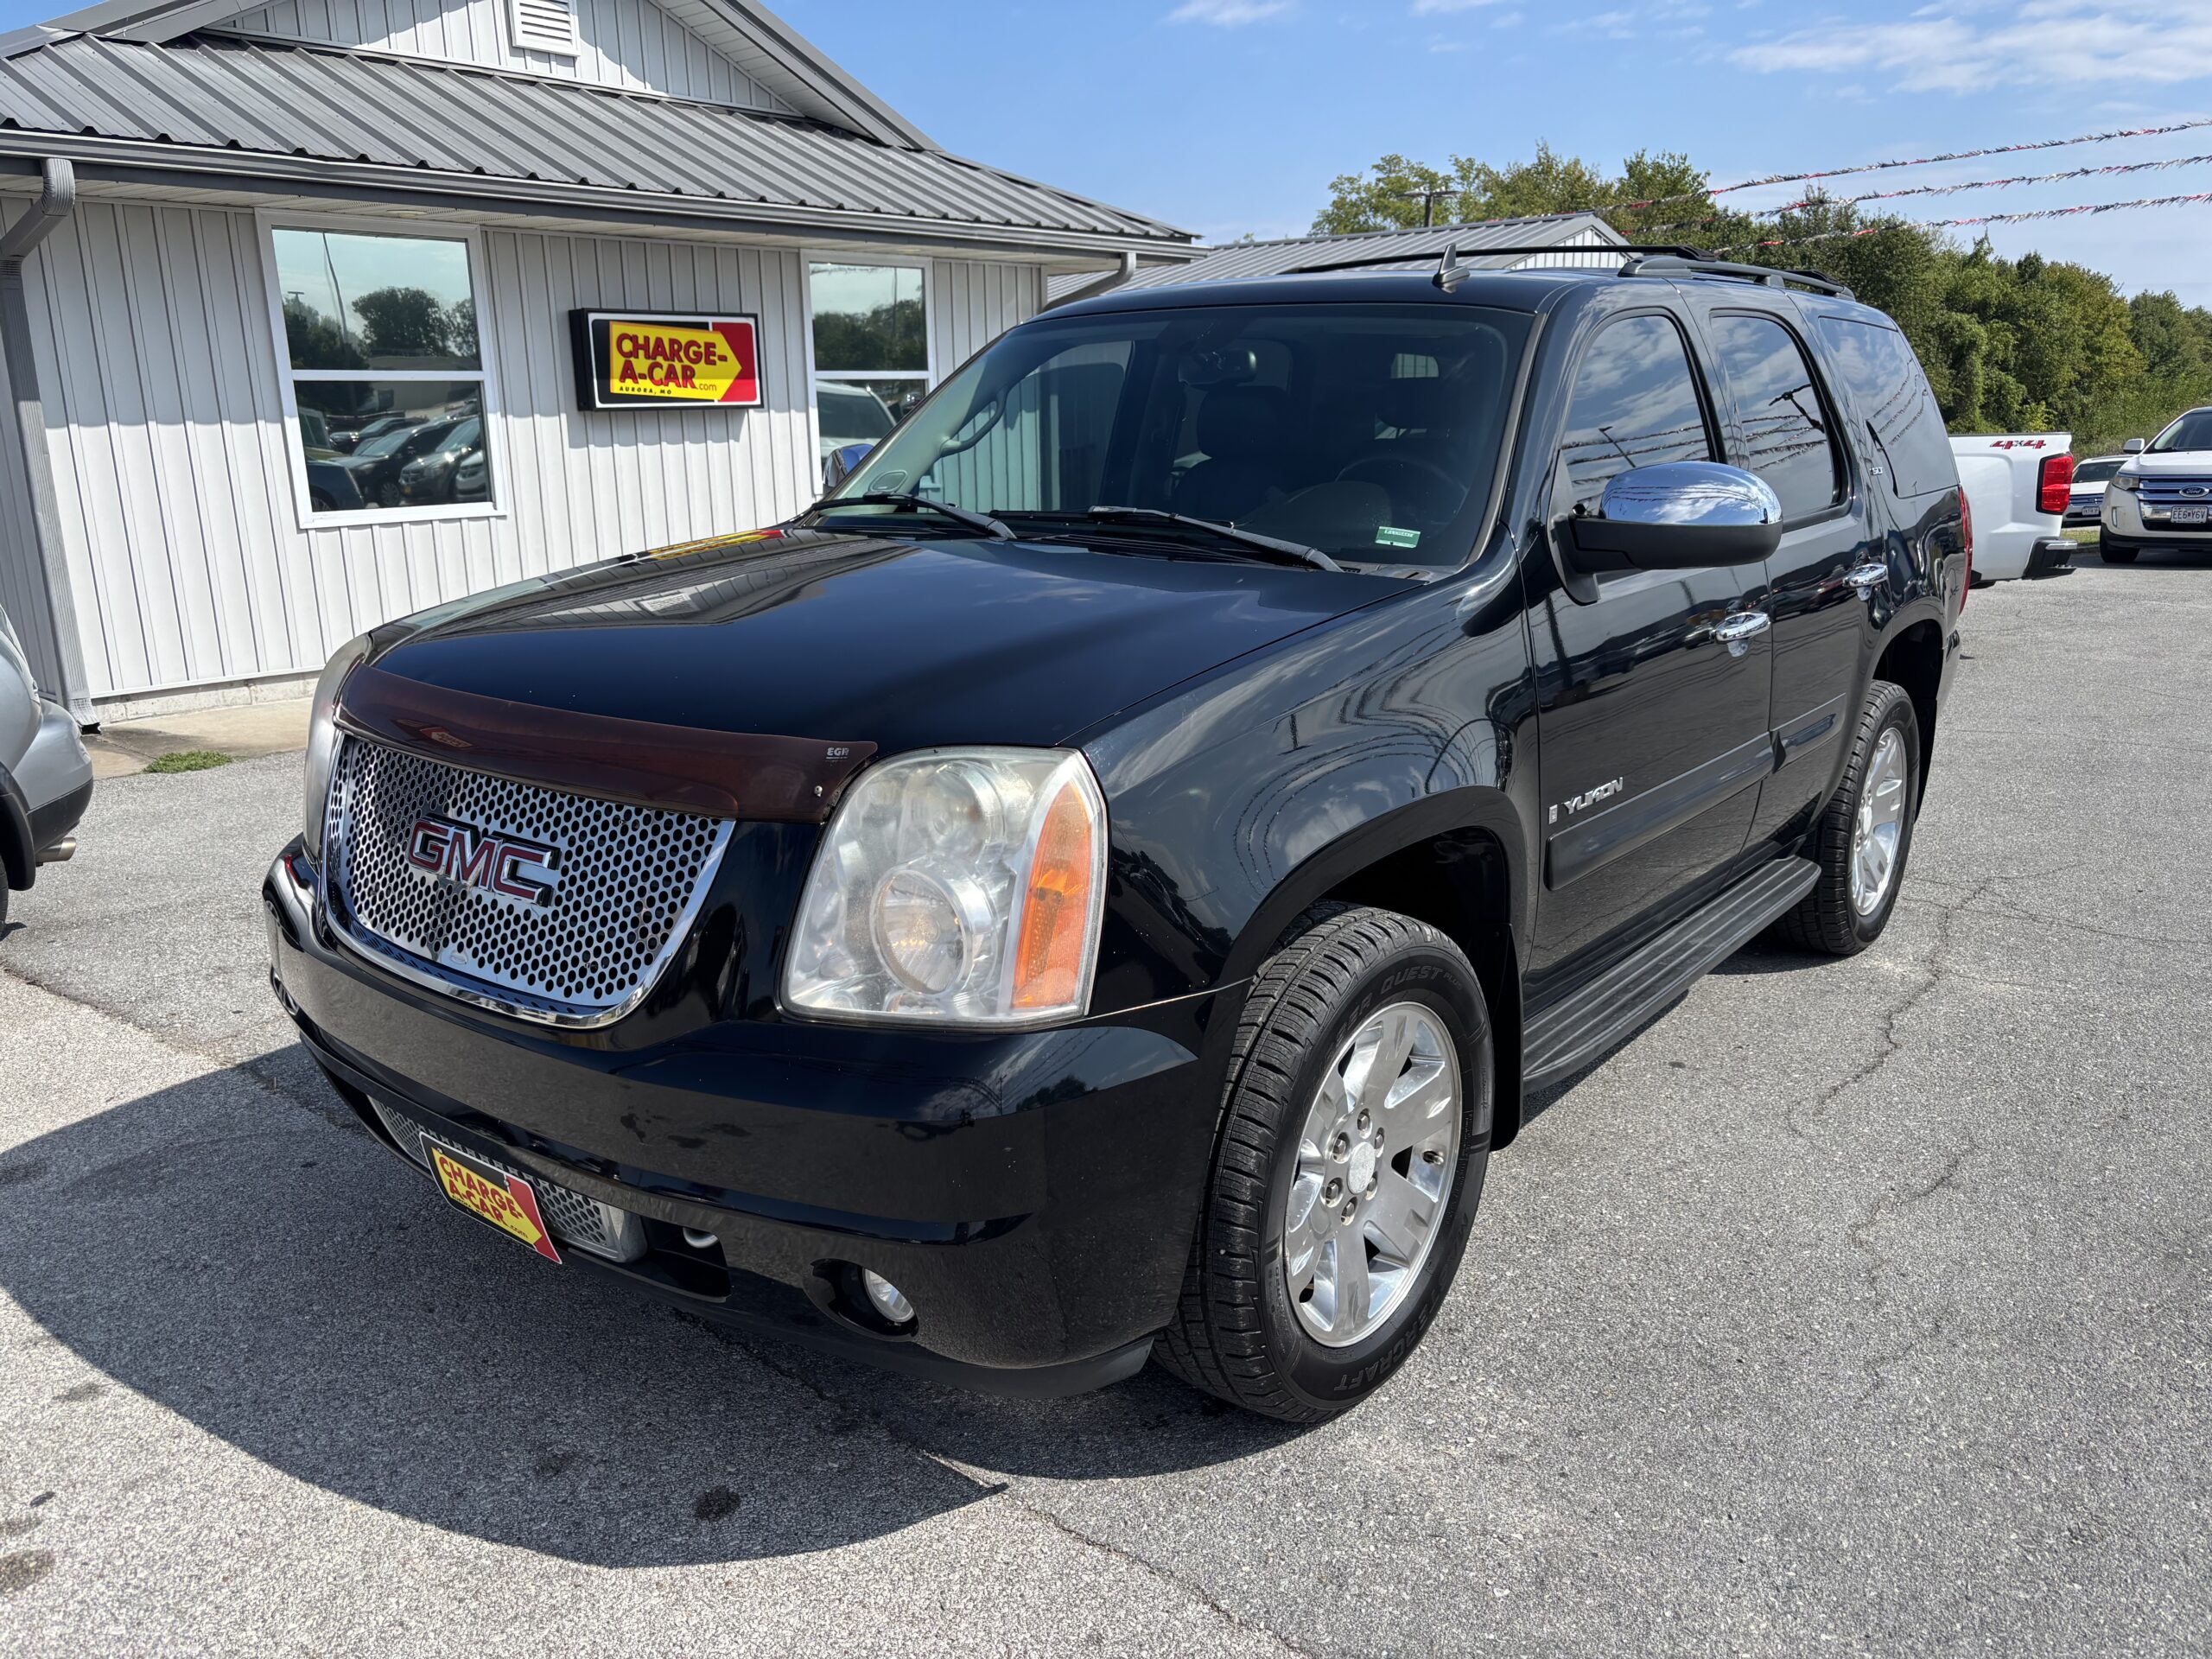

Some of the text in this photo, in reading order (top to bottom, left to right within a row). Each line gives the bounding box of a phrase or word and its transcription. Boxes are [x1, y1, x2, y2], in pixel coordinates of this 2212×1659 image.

[616, 332, 728, 365] CHARGE-
[620, 385, 656, 395] AURORA,
[827, 747, 849, 756] EGR
[1562, 776, 1624, 815] YUKON
[409, 817, 556, 906] GMC
[1380, 965, 1444, 995] QUEST
[1442, 972, 1463, 991] PLUS
